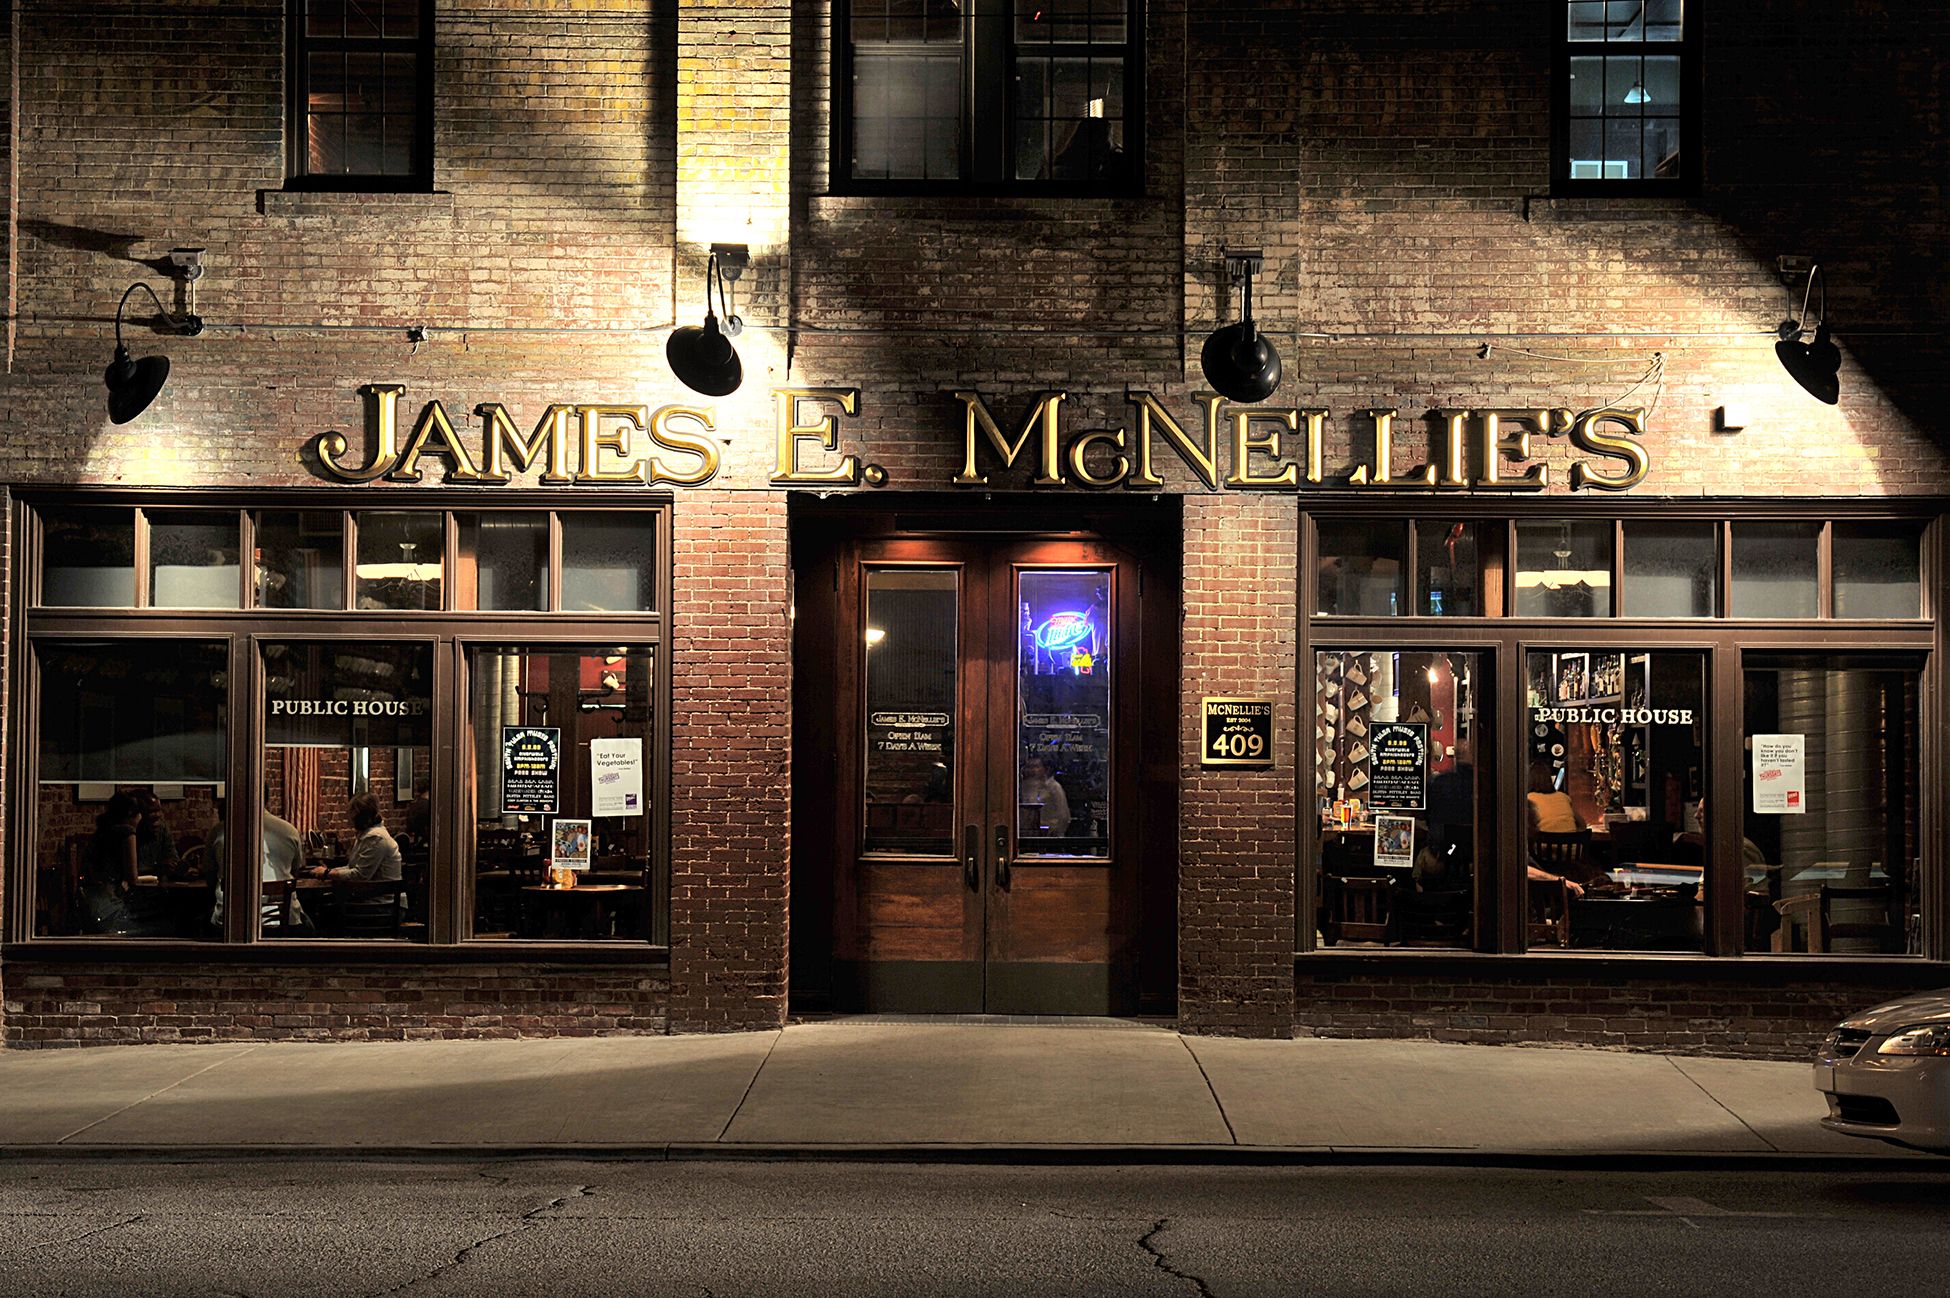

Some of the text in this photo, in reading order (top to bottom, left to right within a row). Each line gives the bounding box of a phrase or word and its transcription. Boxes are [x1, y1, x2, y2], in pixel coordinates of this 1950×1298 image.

[312, 384, 721, 487] JAMES
[768, 386, 889, 487] E.
[271, 700, 348, 715] PUBLIC
[1538, 707, 1693, 725] PUBLIC HOUSE
[908, 742, 917, 750] A
[1212, 733, 1264, 757] 409
